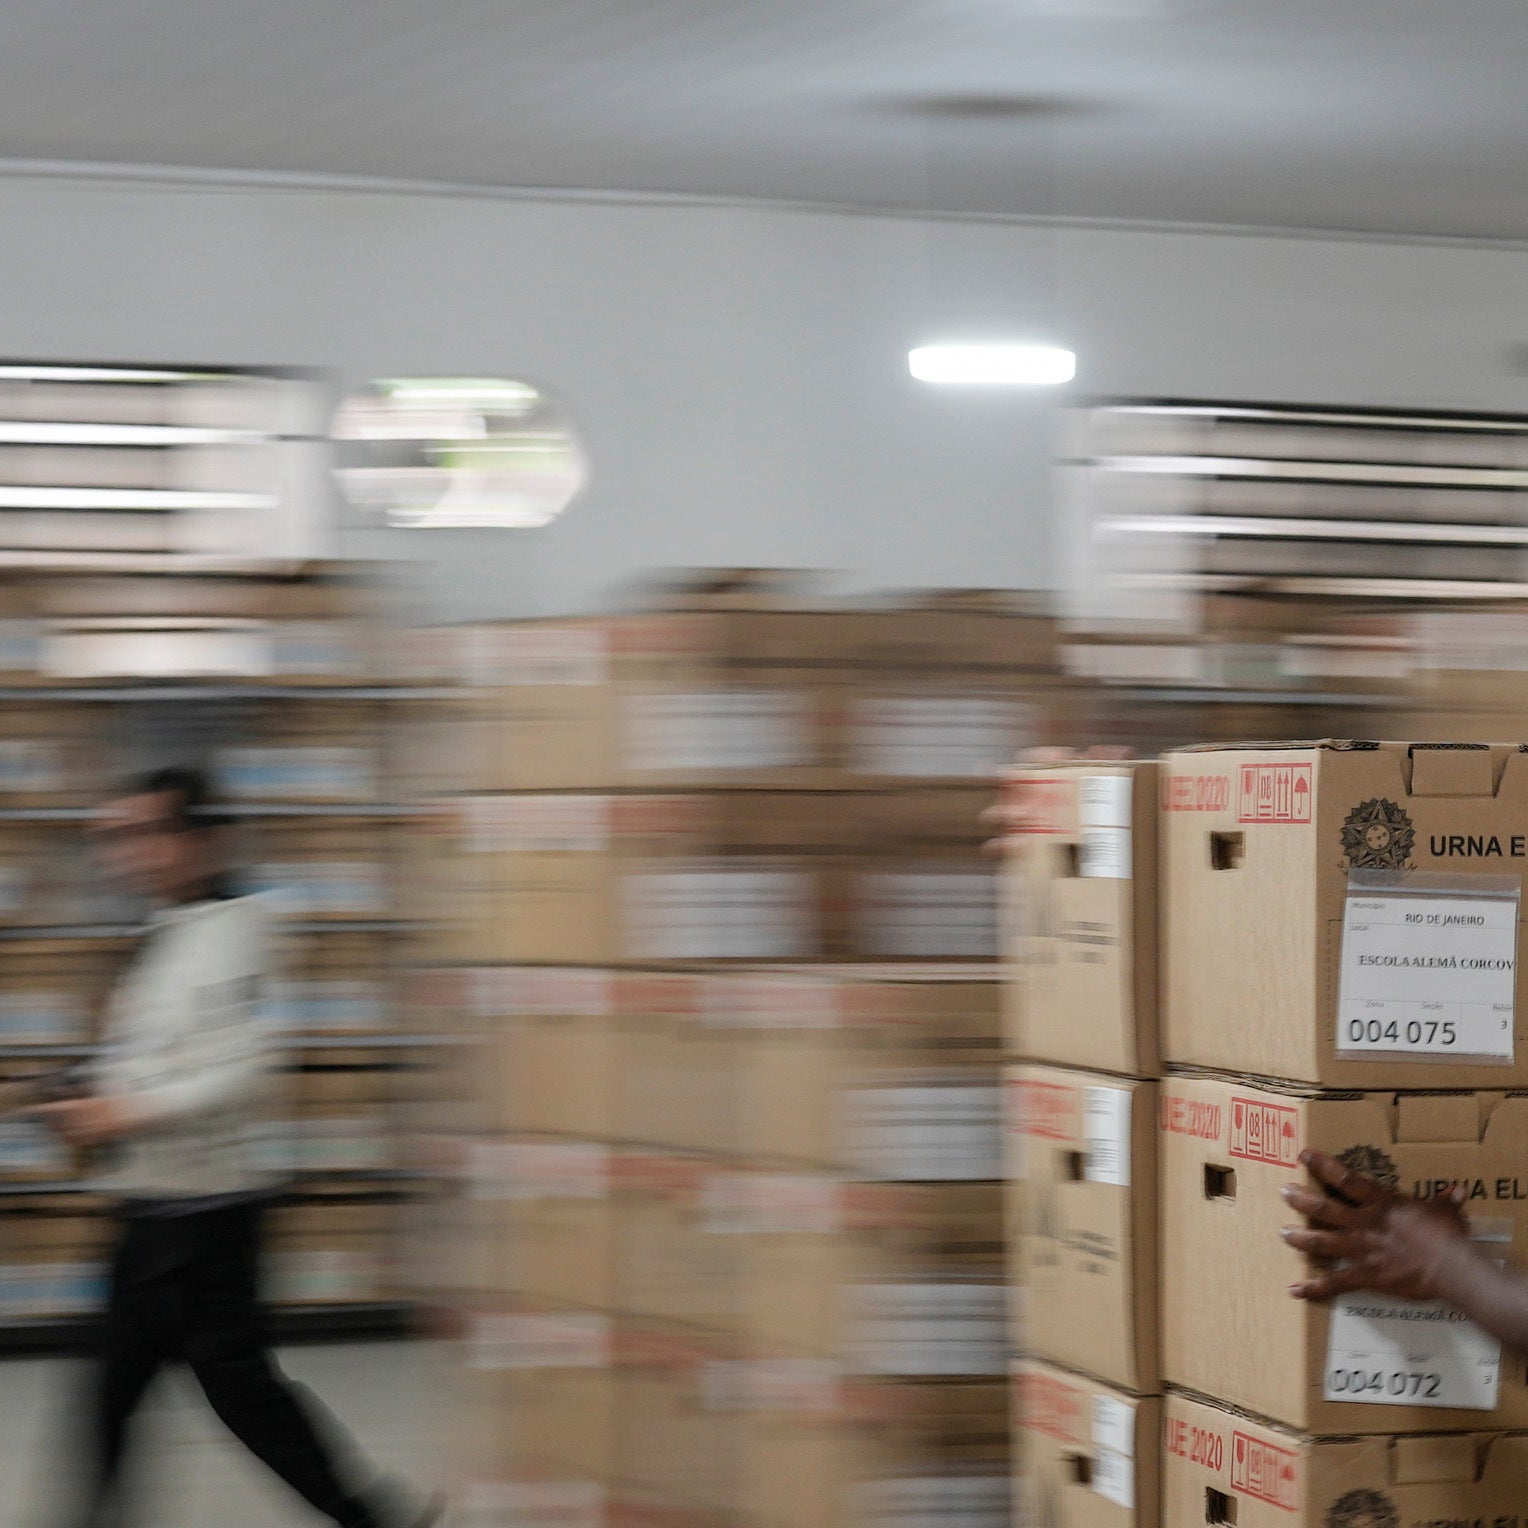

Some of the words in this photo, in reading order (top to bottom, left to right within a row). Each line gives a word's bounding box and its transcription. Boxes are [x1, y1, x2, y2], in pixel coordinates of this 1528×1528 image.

[1429, 833, 1504, 859] URNA
[1405, 913, 1424, 924] RIO
[1426, 914, 1441, 925] DE
[1442, 914, 1485, 927] JANEIRO
[1358, 954, 1411, 967] ESCOLA
[1411, 954, 1457, 970] ALEMÃ
[1349, 1018, 1400, 1043] 004
[1406, 1020, 1457, 1045] 075
[1500, 1020, 1508, 1030] 3
[1328, 1368, 1384, 1394] 004
[1387, 1370, 1442, 1398] 072
[1190, 1426, 1223, 1472] 2020
